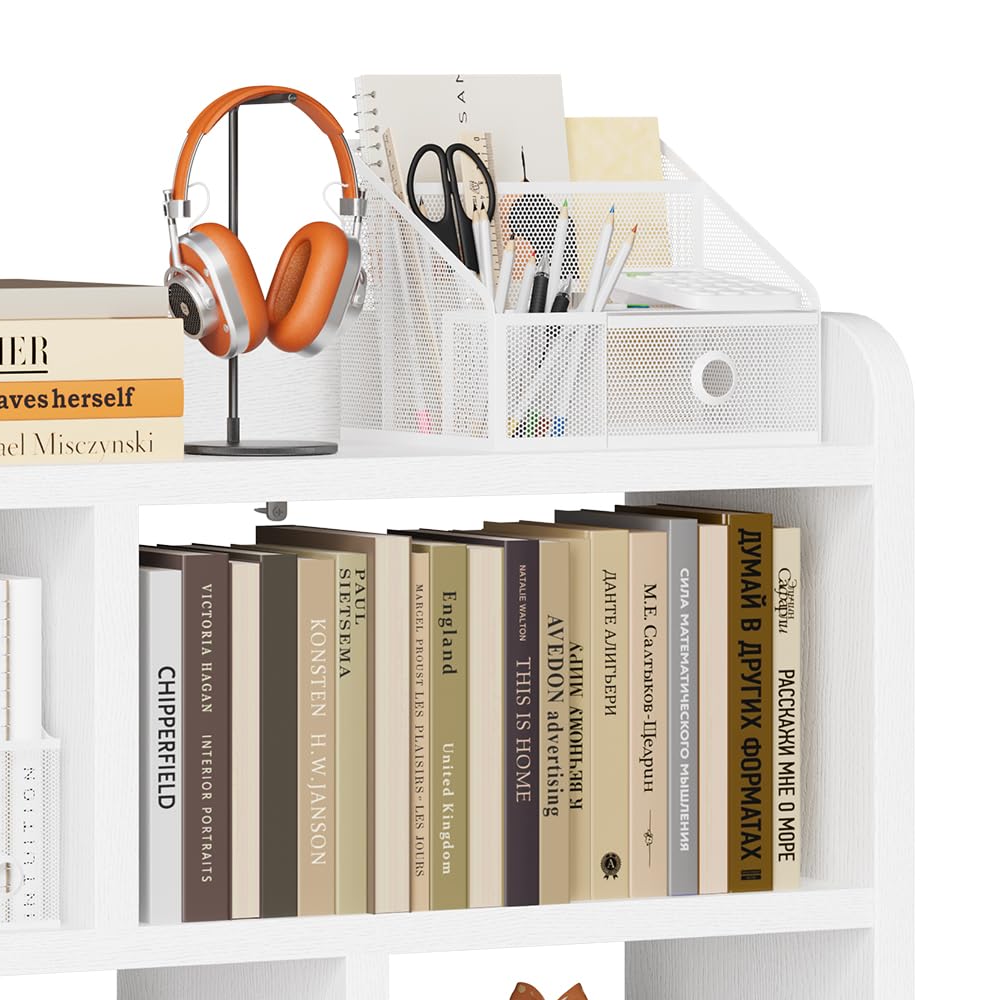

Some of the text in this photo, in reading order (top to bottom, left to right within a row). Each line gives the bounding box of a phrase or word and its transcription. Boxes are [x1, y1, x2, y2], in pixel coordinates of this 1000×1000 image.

[33, 430, 153, 462] Misczynski
[51, 386, 135, 409] herself
[339, 568, 352, 678] SIETSEMA
[354, 568, 367, 625] PAUL
[415, 584, 424, 632] MARCEL
[439, 590, 457, 675] England
[602, 569, 617, 716] ДАНТЕ АЛИГЬЕРИ
[774, 568, 791, 634] Сафарли
[310, 618, 326, 717] KONSTEN
[415, 639, 424, 686] PROUST
[415, 692, 424, 718] LES
[640, 584, 658, 793] М.Е. Салтыков-Щедрин
[680, 568, 690, 851] СИЛА МАТЕМАТИЧЕСКОГО МЫШЛЕНИЯ
[738, 527, 767, 861] ДУМАЙ В ДРУГИХ ФОРМАТАХ
[158, 665, 176, 809] CHIPPERFIELD
[201, 583, 213, 883] VICTORIA HAGAN INTERIOR PORTRAITS
[415, 725, 424, 793] PLAISIRS
[516, 657, 531, 803] THIS IS HOME
[543, 615, 564, 817] AVEDON advertising
[569, 641, 583, 810] К ВЕЧНОМУ МИРУ
[778, 669, 795, 862] РАССКАЖИ МНЕ О МОРЕ
[415, 805, 424, 830] LES
[415, 835, 425, 877] JOURS
[439, 743, 455, 875] United Kingdom
